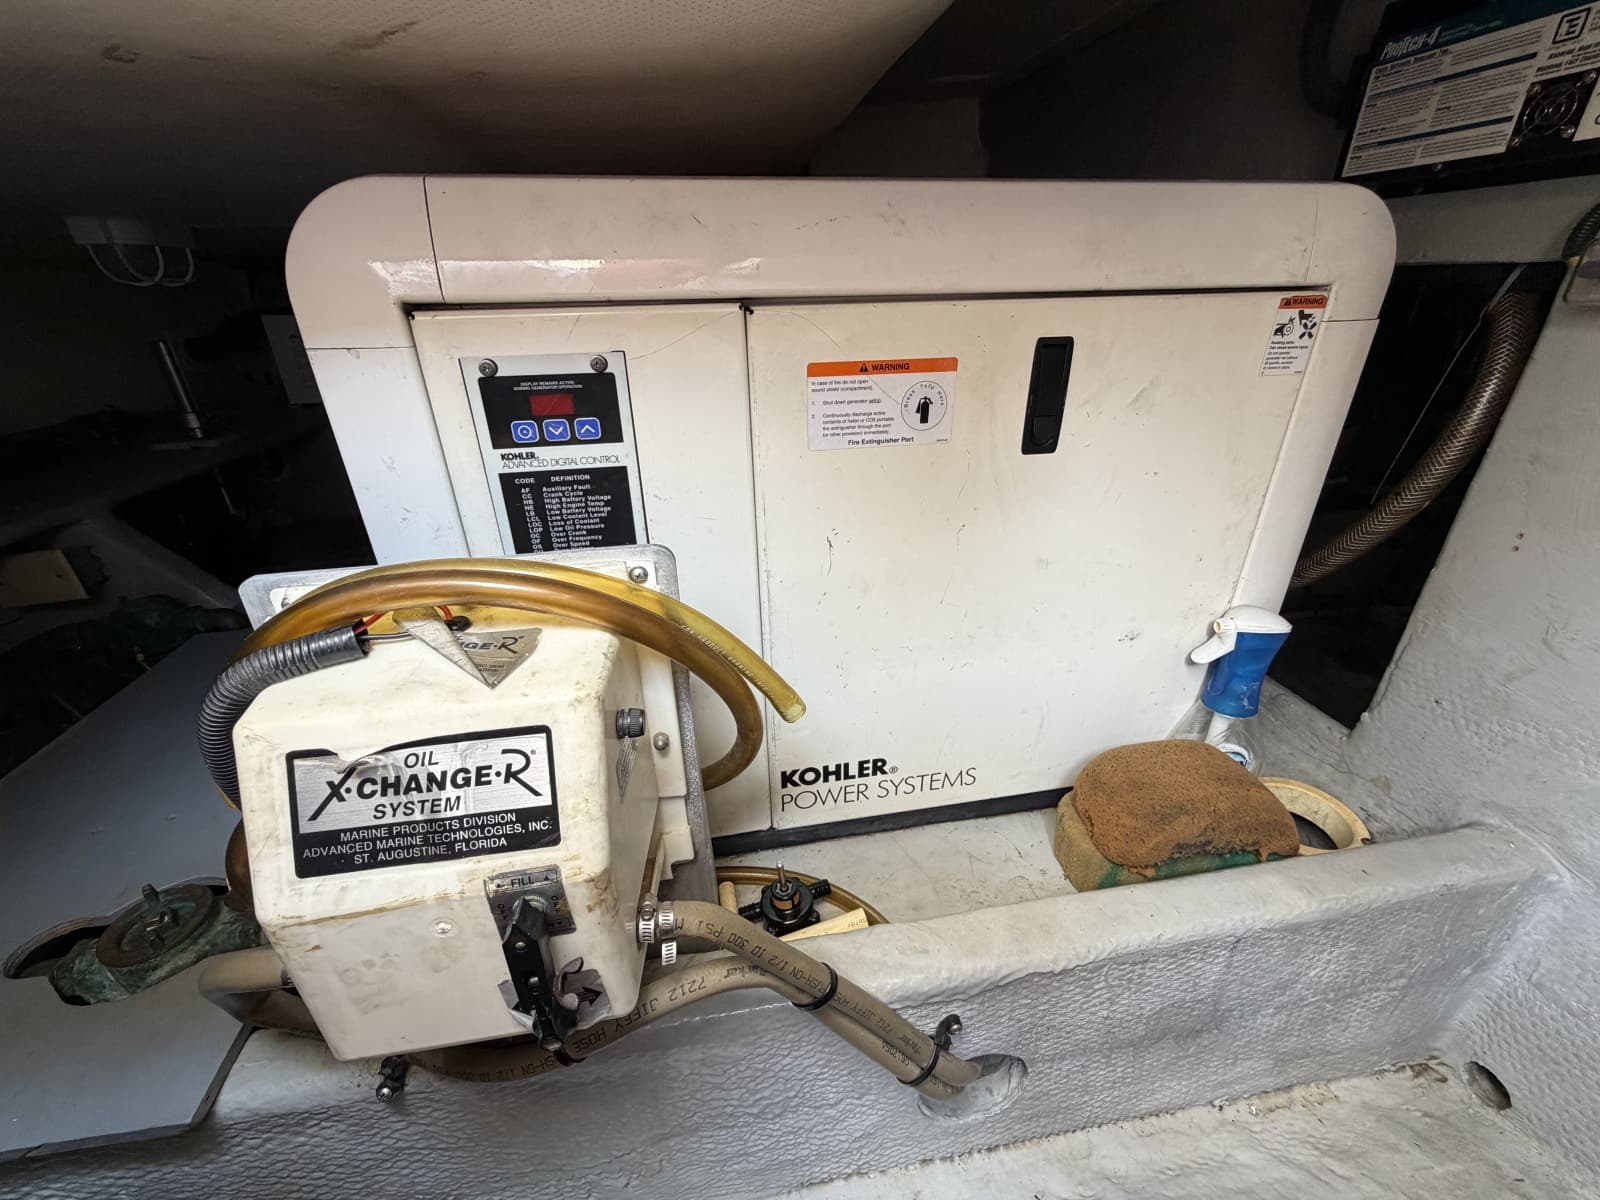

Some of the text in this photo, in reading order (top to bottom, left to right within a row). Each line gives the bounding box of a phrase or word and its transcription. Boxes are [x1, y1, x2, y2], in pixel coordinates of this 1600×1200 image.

[1292, 297, 1324, 305] WARNING
[872, 362, 910, 371] WARNING
[861, 437, 899, 446] Extinguisher
[502, 455, 620, 469] ADVANCED DIGITAL CONTROL
[403, 750, 440, 769] OIL
[781, 767, 977, 812] POWER SYSTEMS
[372, 795, 462, 820] SYSTEM
[340, 812, 516, 842] MARINE PRODUCTS DIVISION
[302, 841, 373, 859] ADVANCED
[376, 834, 424, 849] MARINE
[428, 824, 525, 844] TECHNOLOGIES,
[353, 837, 508, 865] ST. AUGUSTINE, FLORIDA
[510, 875, 534, 889] FILL
[727, 932, 749, 949] 300
[768, 955, 788, 970] 1/2
[668, 976, 707, 1002] 7212
[571, 1027, 607, 1053] HOSE
